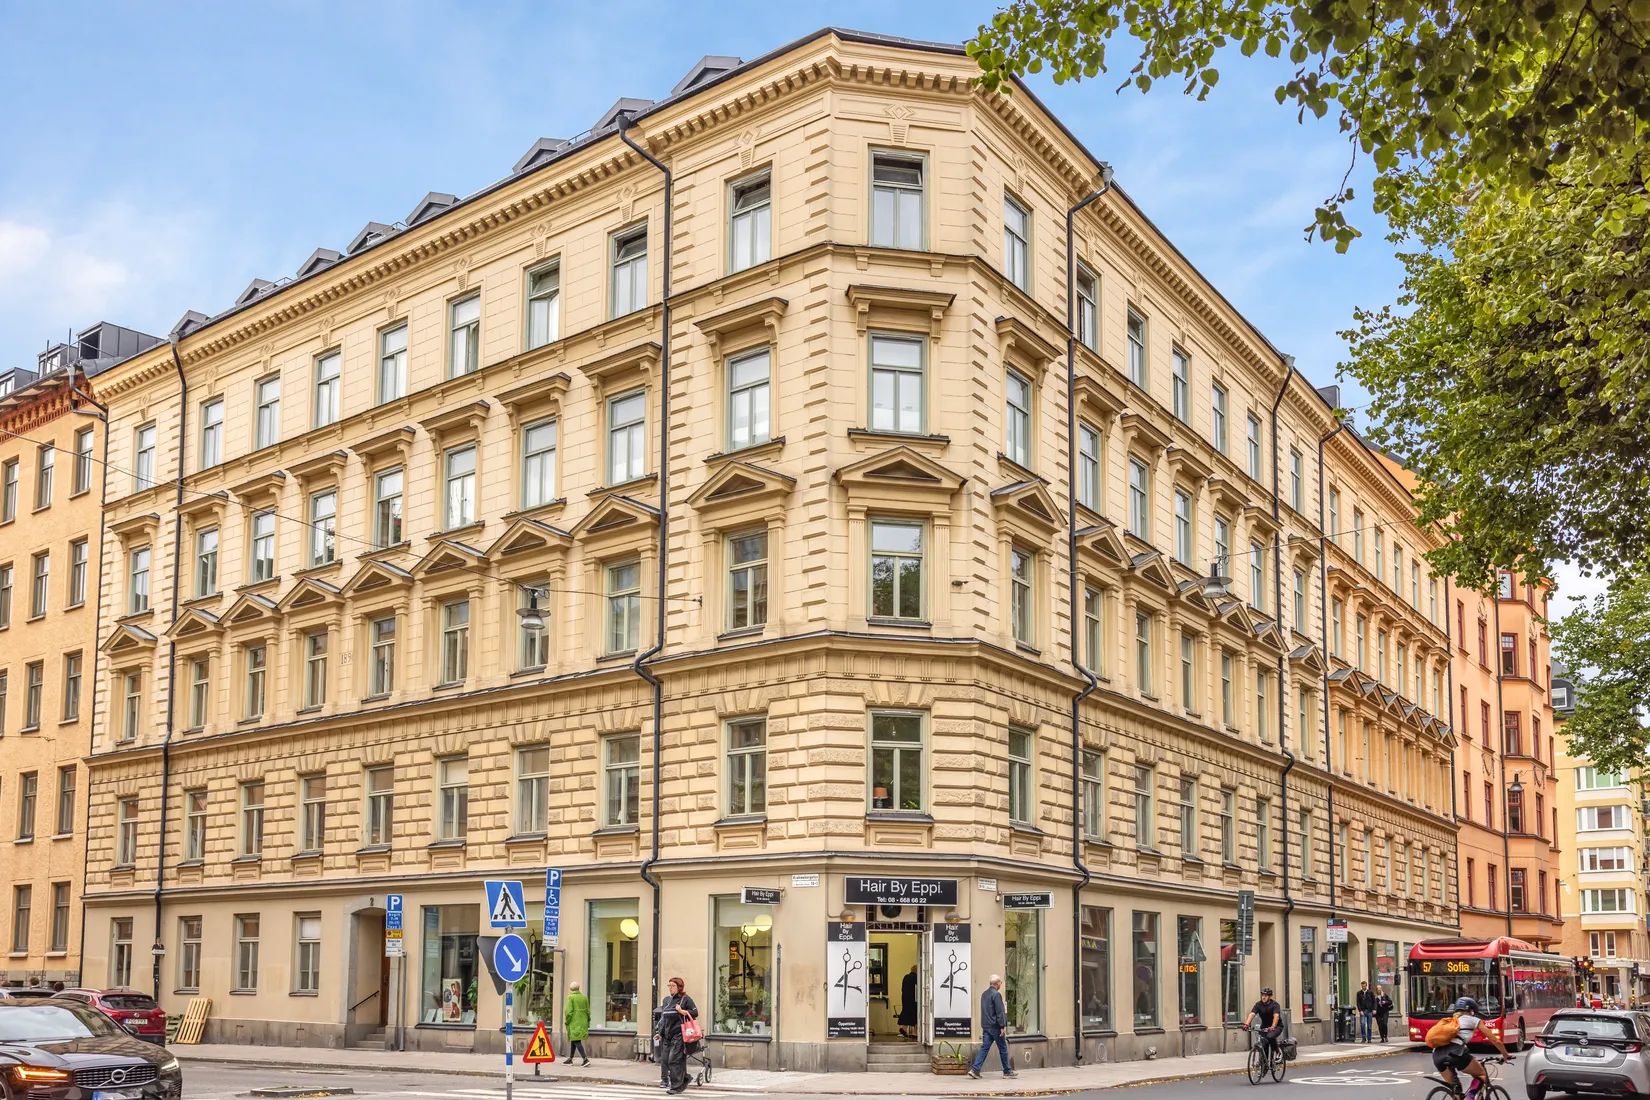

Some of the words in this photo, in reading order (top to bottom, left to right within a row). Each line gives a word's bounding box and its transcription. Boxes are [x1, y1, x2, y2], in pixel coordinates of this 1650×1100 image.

[550, 870, 559, 886] P
[860, 879, 887, 892] Hair
[890, 880, 908, 895] By
[911, 881, 943, 896] Eppi.
[391, 896, 400, 910] P
[1423, 961, 1432, 972] 57
[1447, 961, 1470, 972] Sofia
